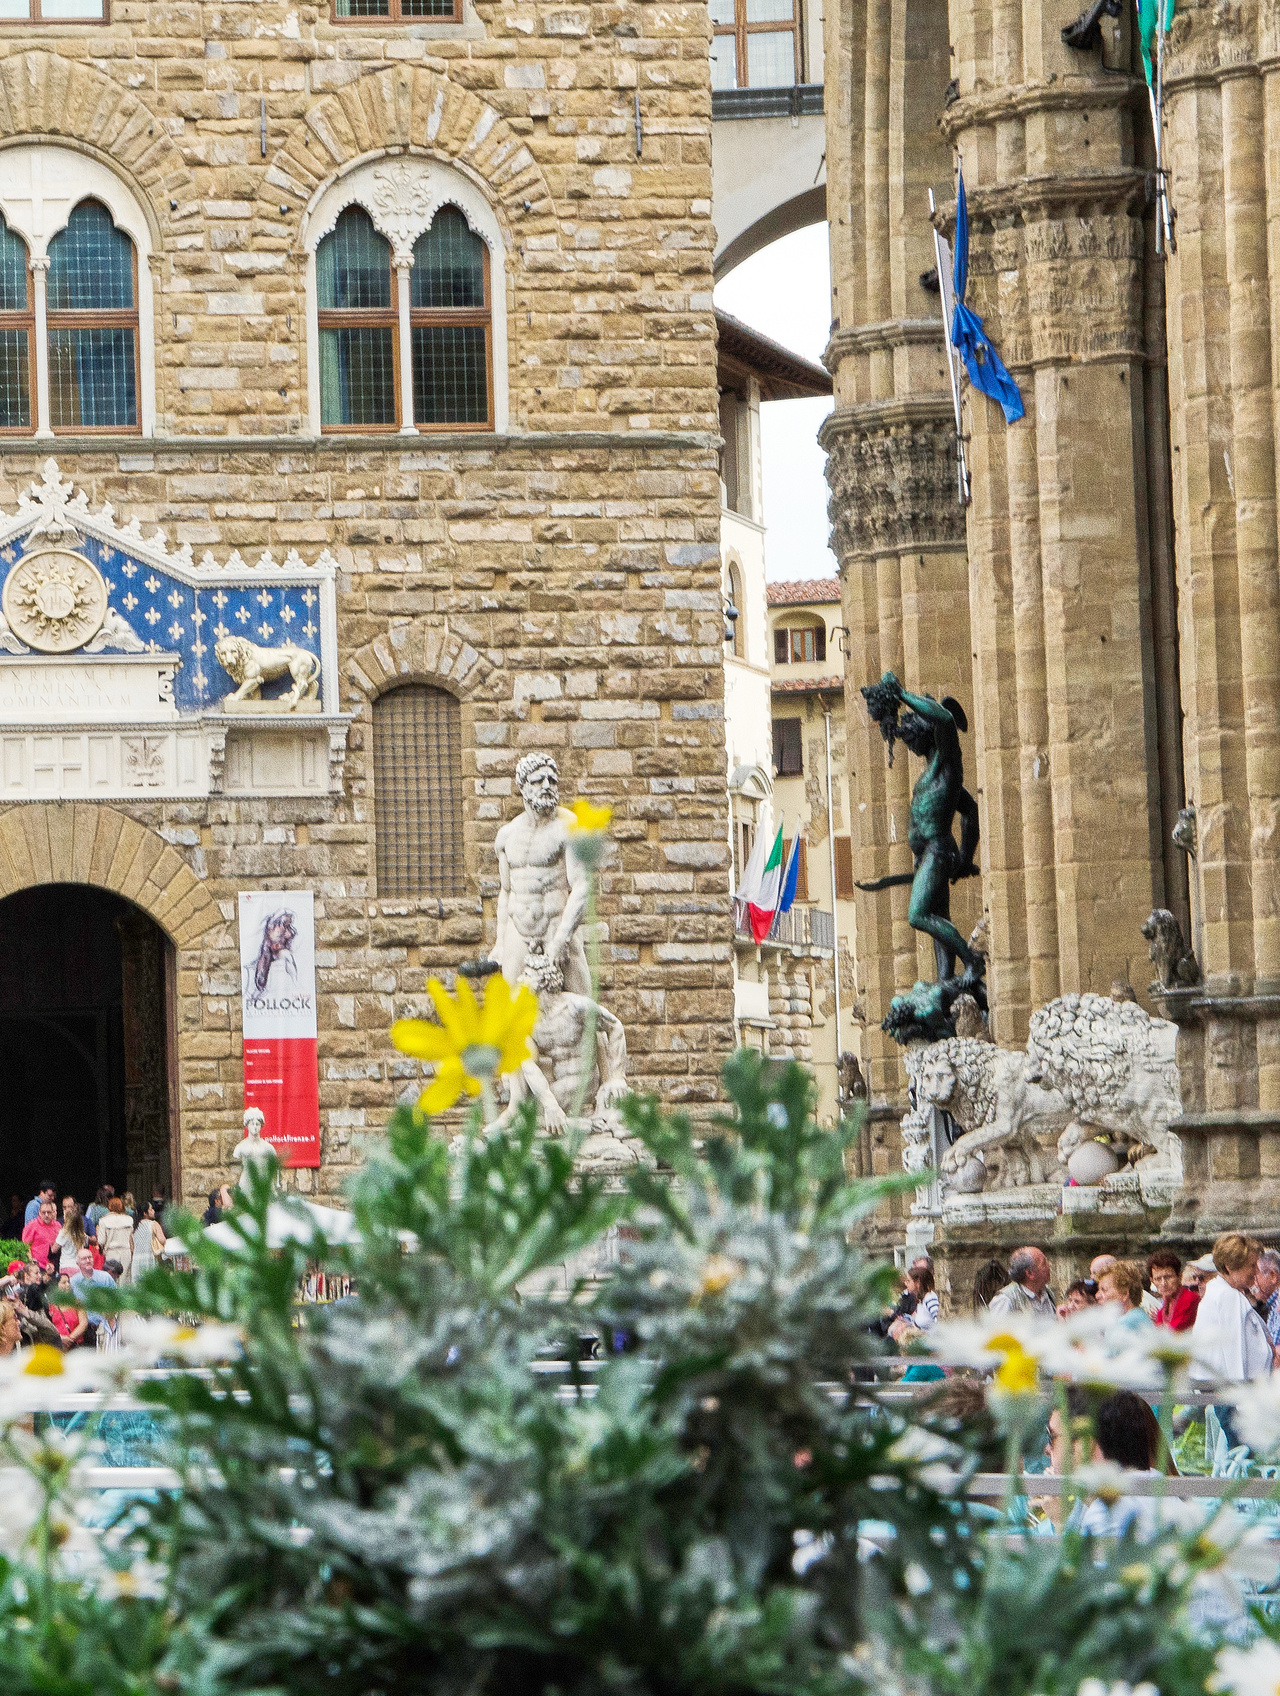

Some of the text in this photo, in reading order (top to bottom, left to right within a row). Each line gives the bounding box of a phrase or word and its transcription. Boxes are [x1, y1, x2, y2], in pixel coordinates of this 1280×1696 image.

[30, 669, 95, 682] REGVM
[108, 668, 131, 681] ET
[245, 998, 311, 1010] POLLOCK
